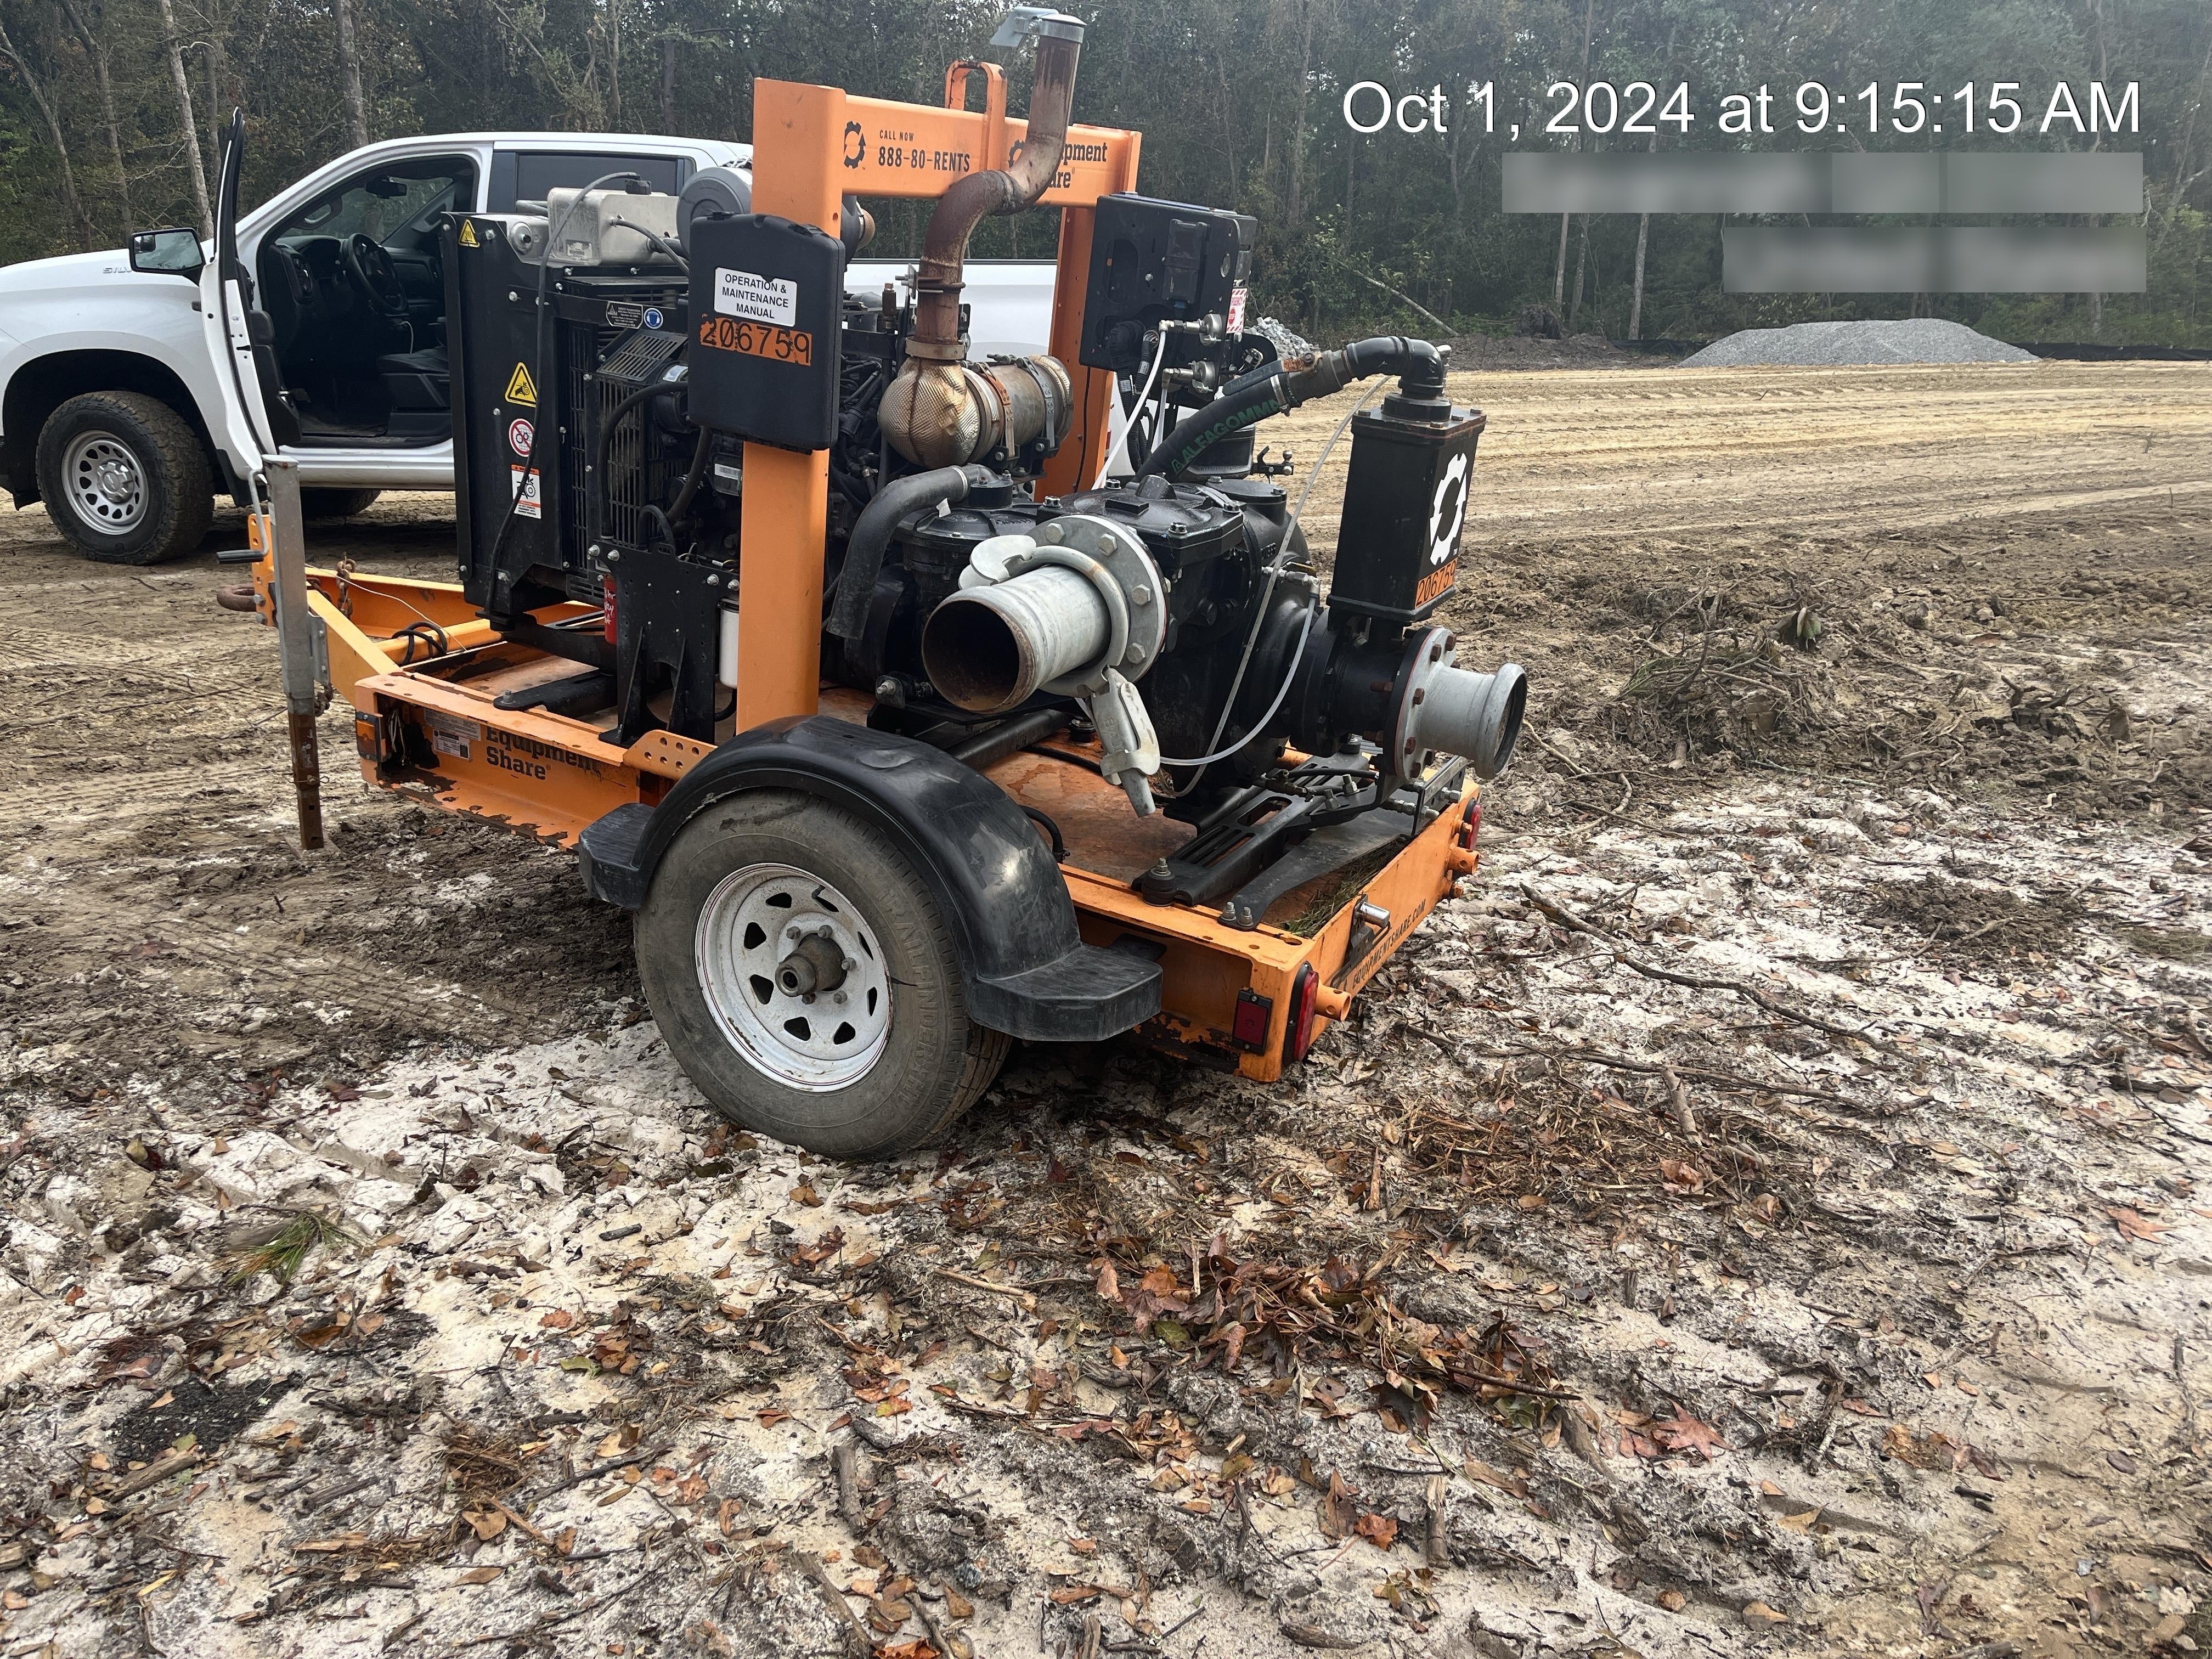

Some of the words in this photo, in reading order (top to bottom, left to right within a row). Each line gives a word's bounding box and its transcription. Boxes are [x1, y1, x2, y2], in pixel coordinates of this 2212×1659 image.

[879, 129, 897, 141] CALL
[900, 131, 915, 143] NOW
[878, 145, 971, 173] 888-80-RENTS
[1062, 142, 1108, 166] pment
[725, 274, 777, 292] OPERATION
[780, 284, 787, 294] &
[722, 286, 789, 308] MAINTENANCE
[736, 303, 775, 319] MANUAL
[702, 318, 810, 363] 206759
